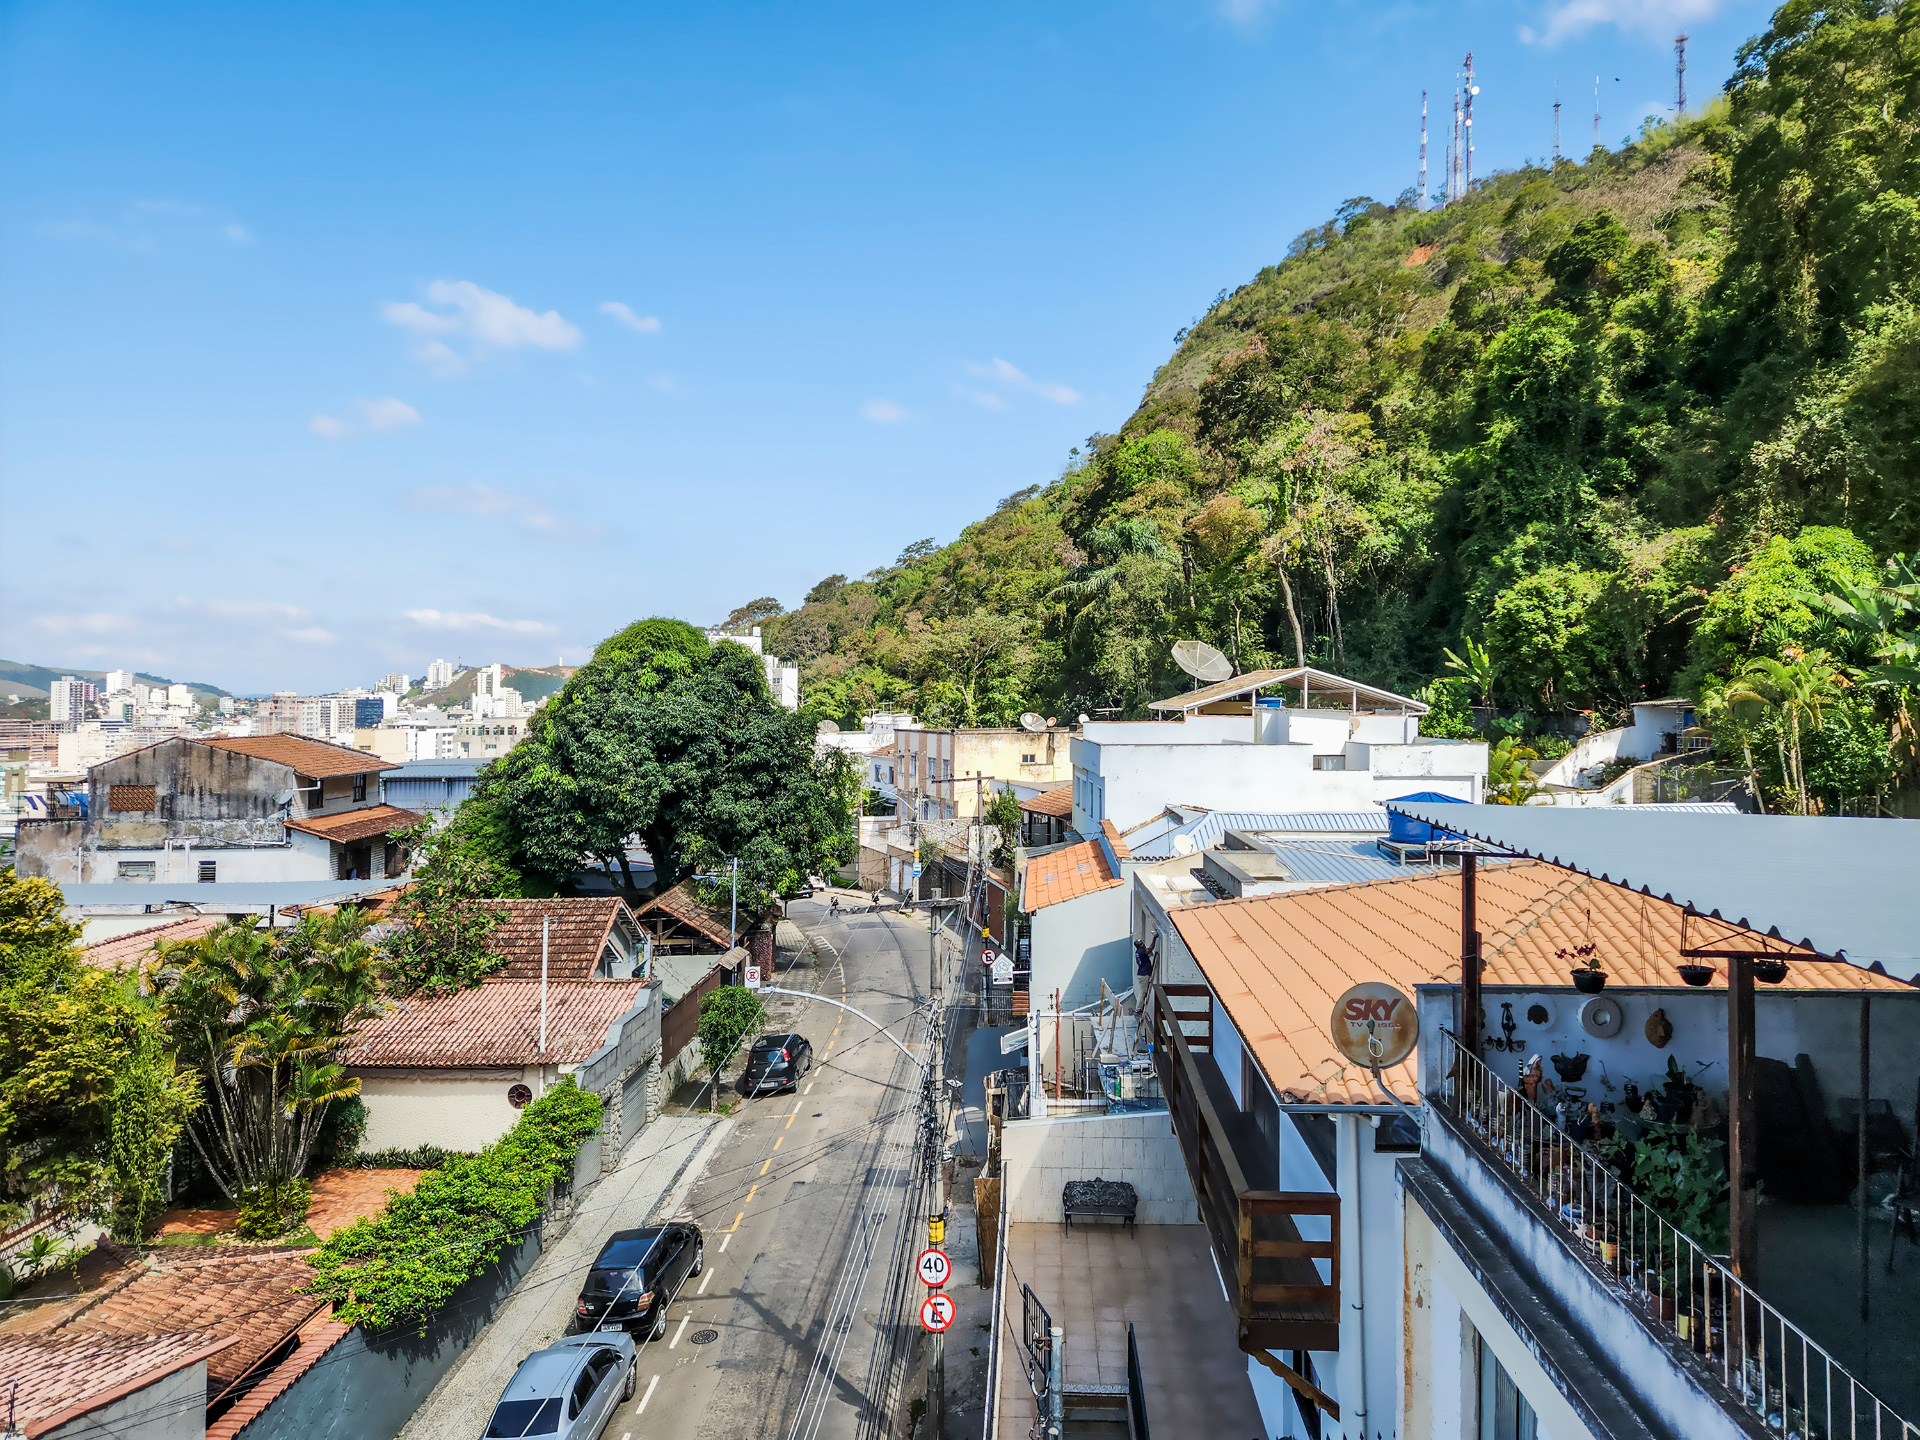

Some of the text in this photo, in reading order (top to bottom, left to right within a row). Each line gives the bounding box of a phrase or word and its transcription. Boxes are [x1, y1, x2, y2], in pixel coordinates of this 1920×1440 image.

[1343, 998, 1402, 1021] SKY
[923, 1257, 944, 1273] 40
[931, 1302, 945, 1324] E
